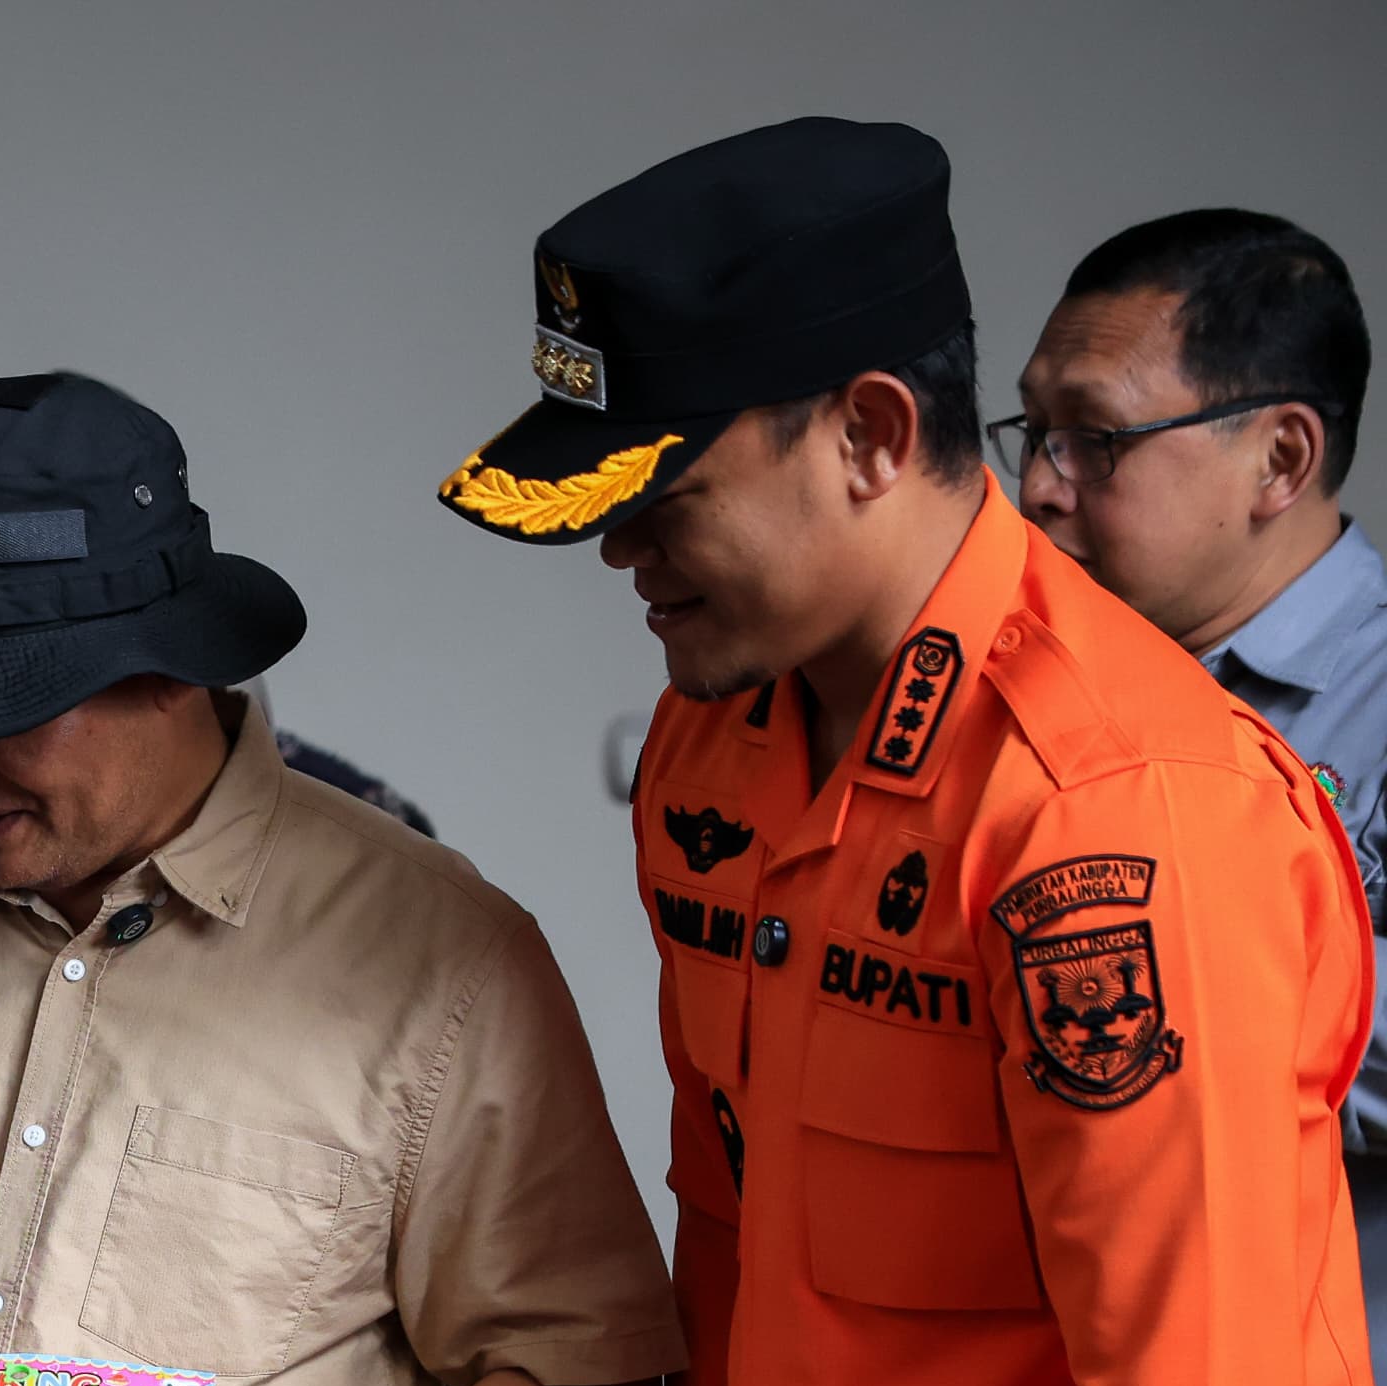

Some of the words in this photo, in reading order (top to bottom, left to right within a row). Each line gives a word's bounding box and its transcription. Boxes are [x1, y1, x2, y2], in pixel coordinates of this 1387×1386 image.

[1070, 862, 1147, 883] KABUPATEN
[1022, 880, 1128, 922] PURBALINGGA
[1022, 926, 1147, 962] PURBALINGGA
[819, 943, 972, 1027] BUPATI
